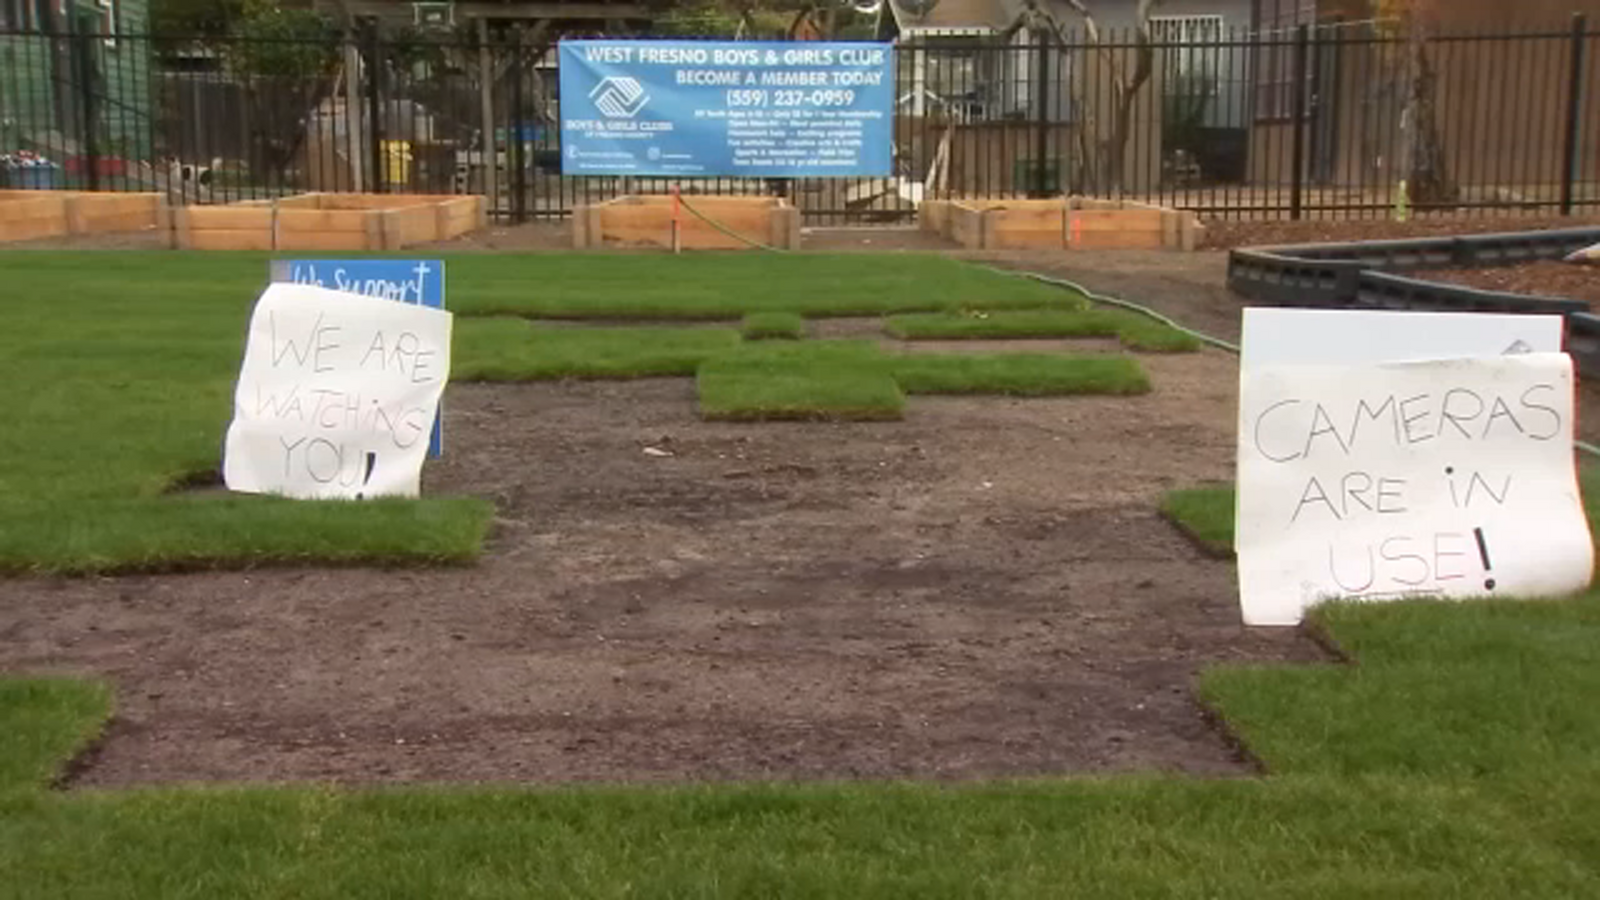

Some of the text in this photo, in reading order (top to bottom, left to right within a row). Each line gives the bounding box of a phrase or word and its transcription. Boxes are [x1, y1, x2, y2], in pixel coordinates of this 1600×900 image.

[586, 47, 884, 65] WEST FRESNO BOYS & GIRLS CLUB
[676, 70, 883, 85] BECOME A MEMBER TODAY
[727, 90, 855, 107] (559) 237-0959
[565, 120, 593, 131] BOYS
[640, 120, 674, 131] CLUBS
[270, 310, 435, 383] WE ARE
[1254, 384, 1561, 463] CAMERAS
[279, 435, 376, 499] YOU!
[1291, 472, 1407, 523] ARE
[1329, 526, 1496, 593] USE!
